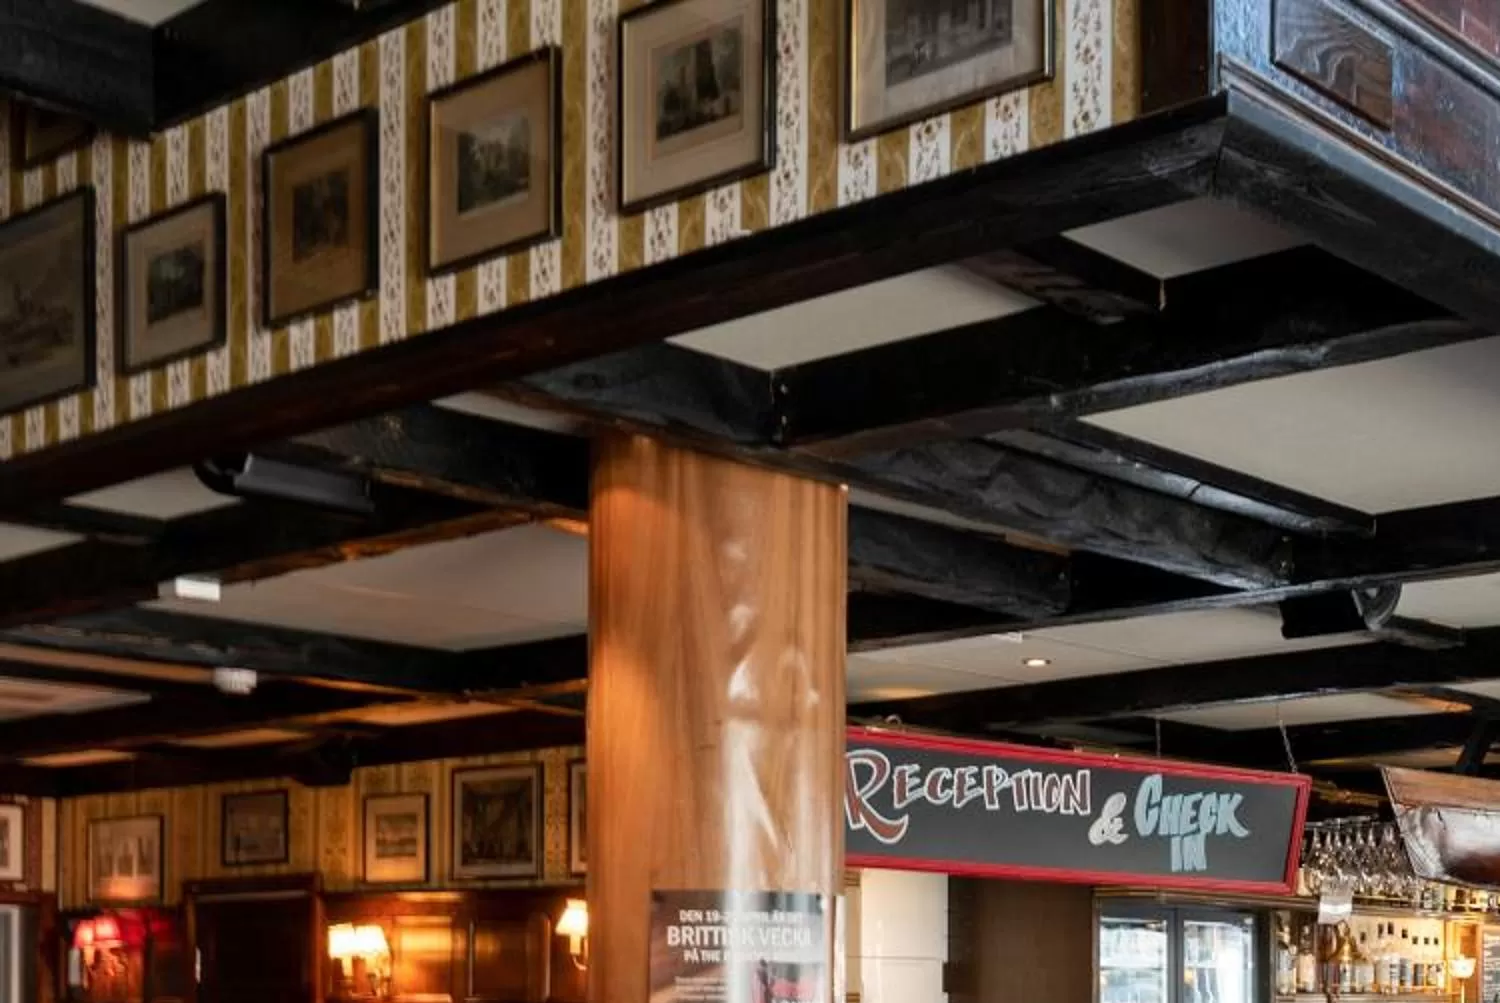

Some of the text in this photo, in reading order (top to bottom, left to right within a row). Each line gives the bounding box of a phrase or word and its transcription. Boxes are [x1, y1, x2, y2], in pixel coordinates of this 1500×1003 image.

[845, 749, 1250, 846] RECEPTION & CHECK
[1170, 831, 1207, 873] IN
